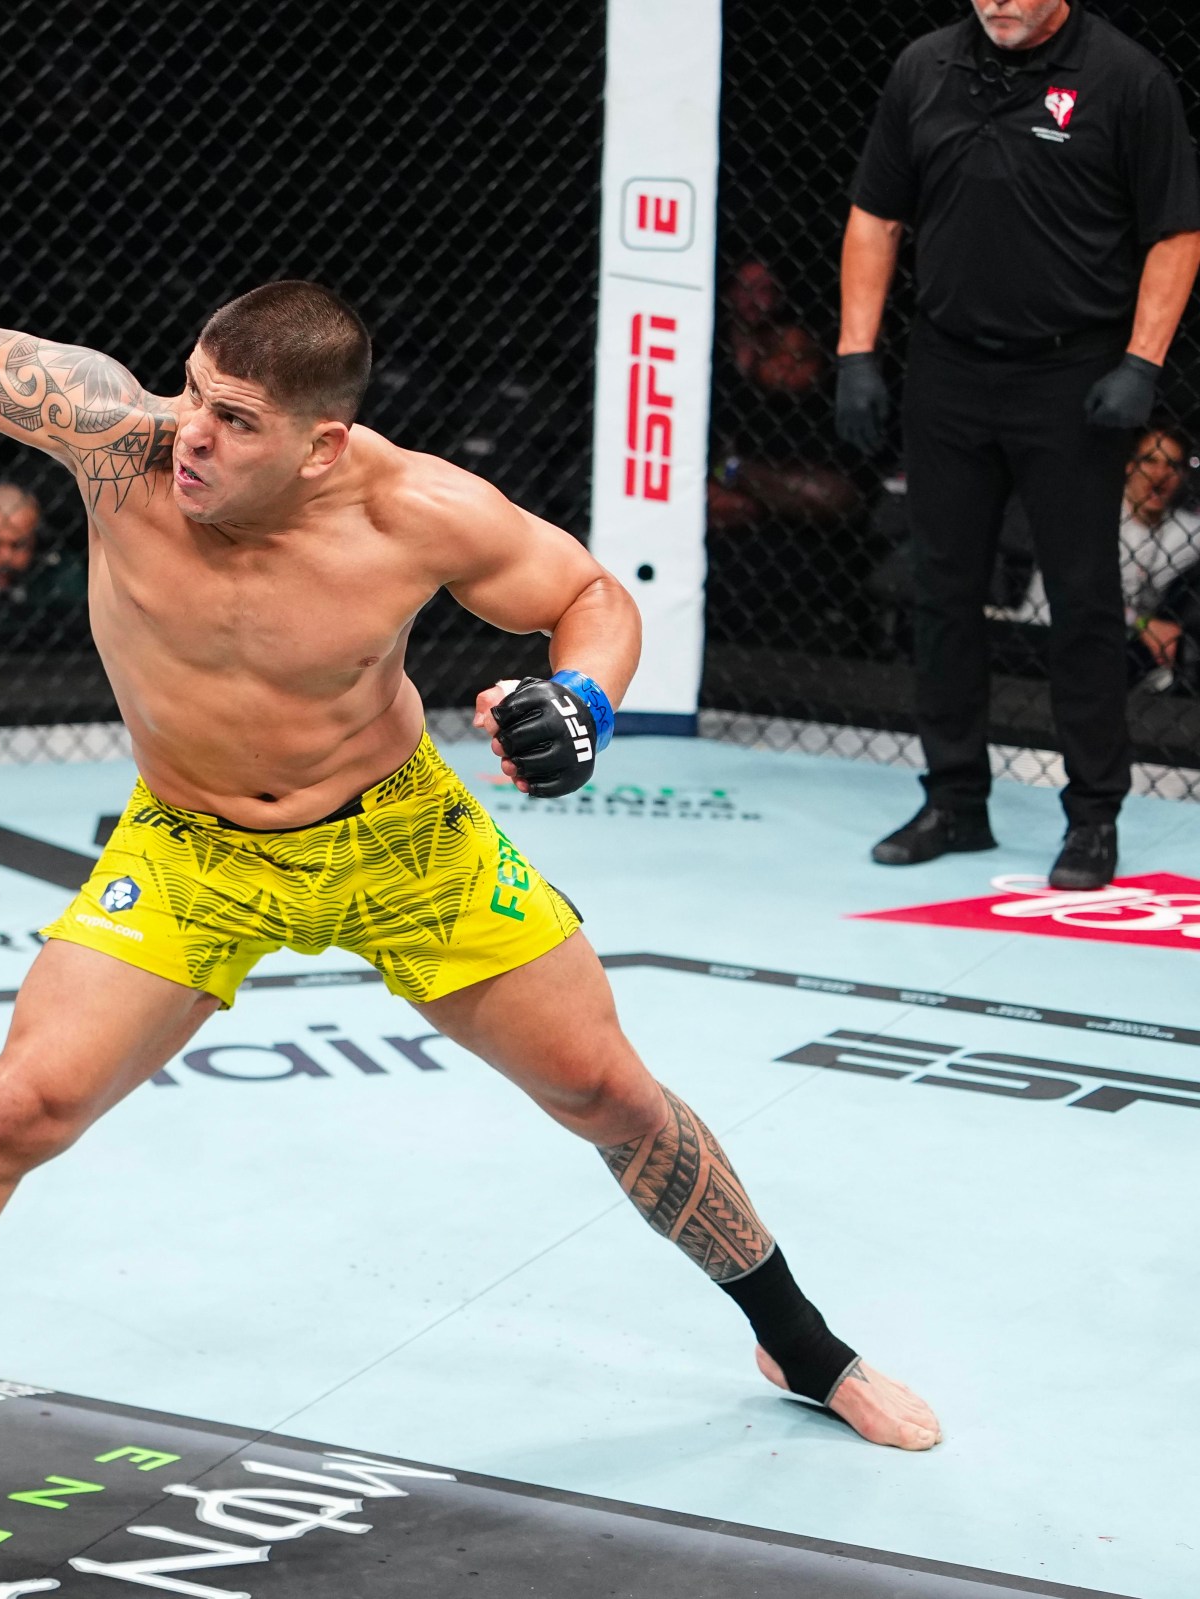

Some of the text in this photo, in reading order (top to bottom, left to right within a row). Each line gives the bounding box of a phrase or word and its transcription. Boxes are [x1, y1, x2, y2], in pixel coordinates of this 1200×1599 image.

[637, 194, 677, 234] E
[625, 313, 677, 502] ESPN
[550, 695, 593, 762] UFC
[132, 807, 197, 844] UFC
[75, 913, 144, 943] crypto.com
[772, 1028, 1200, 1113] ESP
